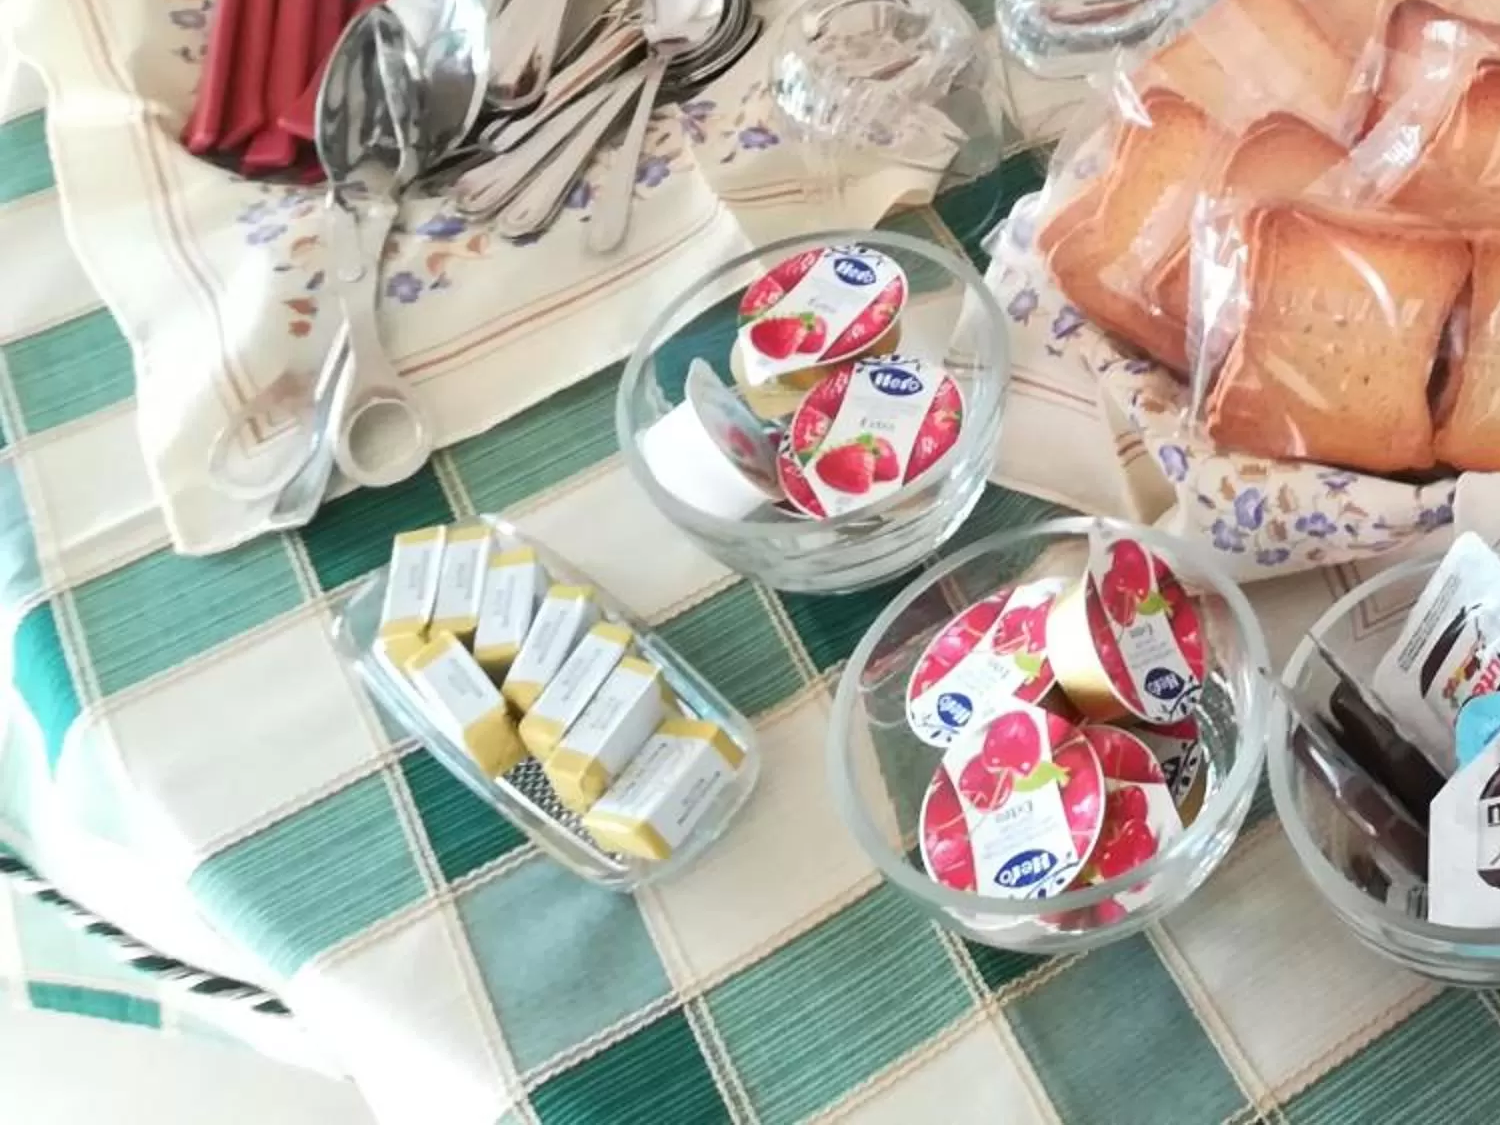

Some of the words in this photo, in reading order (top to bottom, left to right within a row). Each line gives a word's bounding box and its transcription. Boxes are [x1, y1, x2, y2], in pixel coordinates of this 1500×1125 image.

[835, 260, 875, 284] Hero
[874, 371, 921, 392] Hero
[999, 852, 1051, 886] Hero
